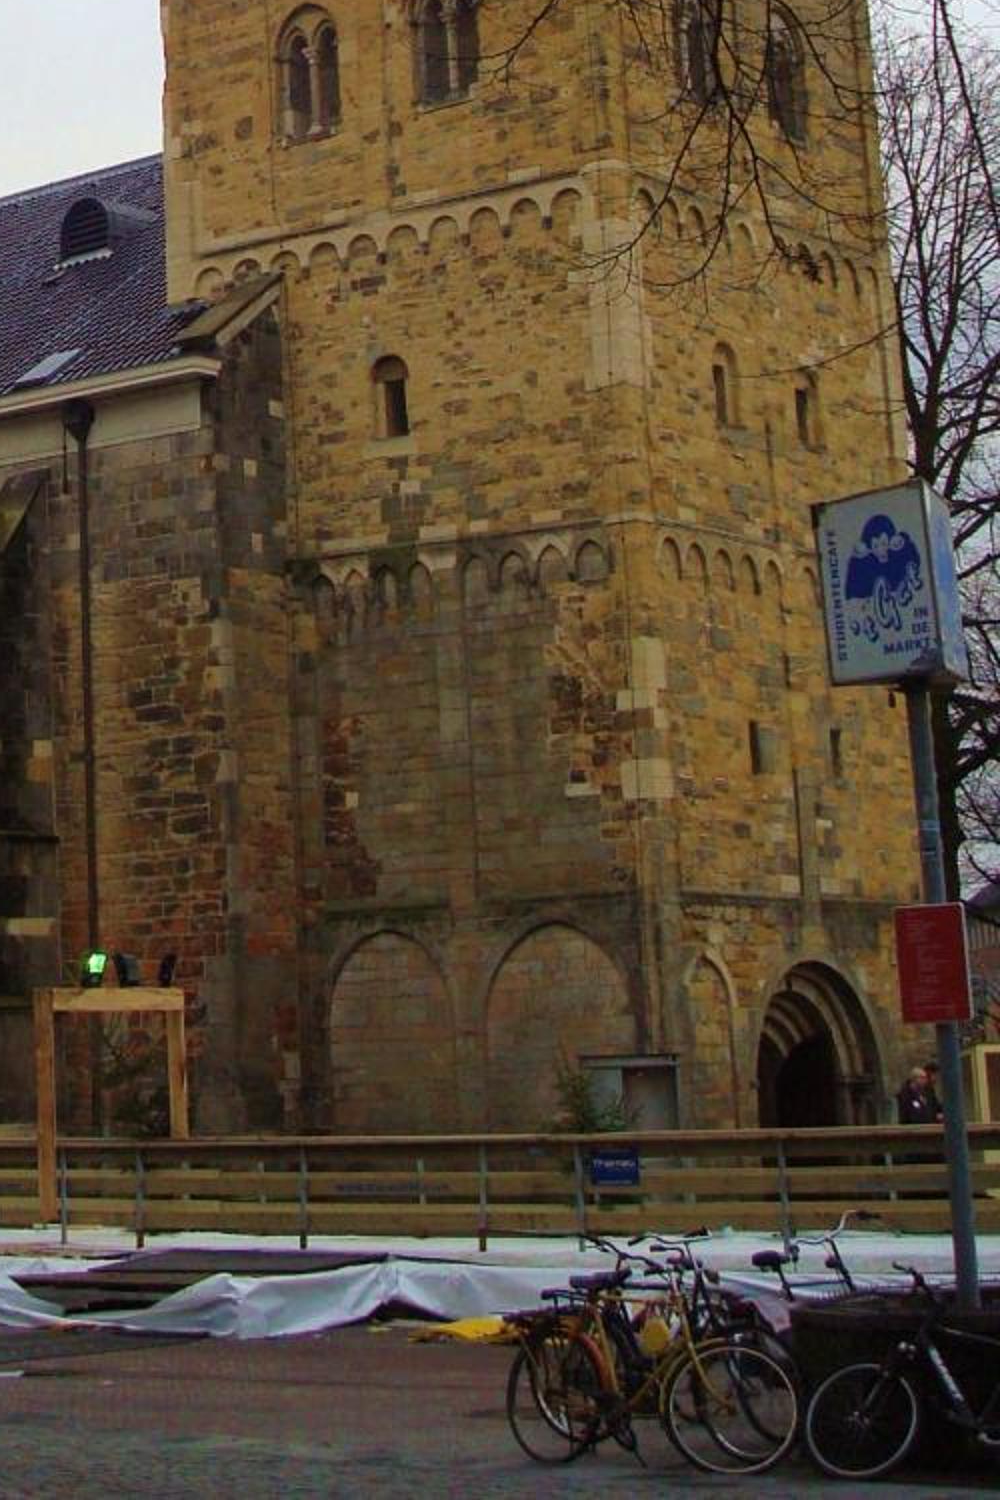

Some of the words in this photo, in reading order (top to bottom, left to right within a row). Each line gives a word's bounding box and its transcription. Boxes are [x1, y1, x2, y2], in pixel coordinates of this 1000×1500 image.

[913, 607, 929, 618] IN
[911, 621, 930, 636] DE
[882, 637, 932, 655] MARKT
